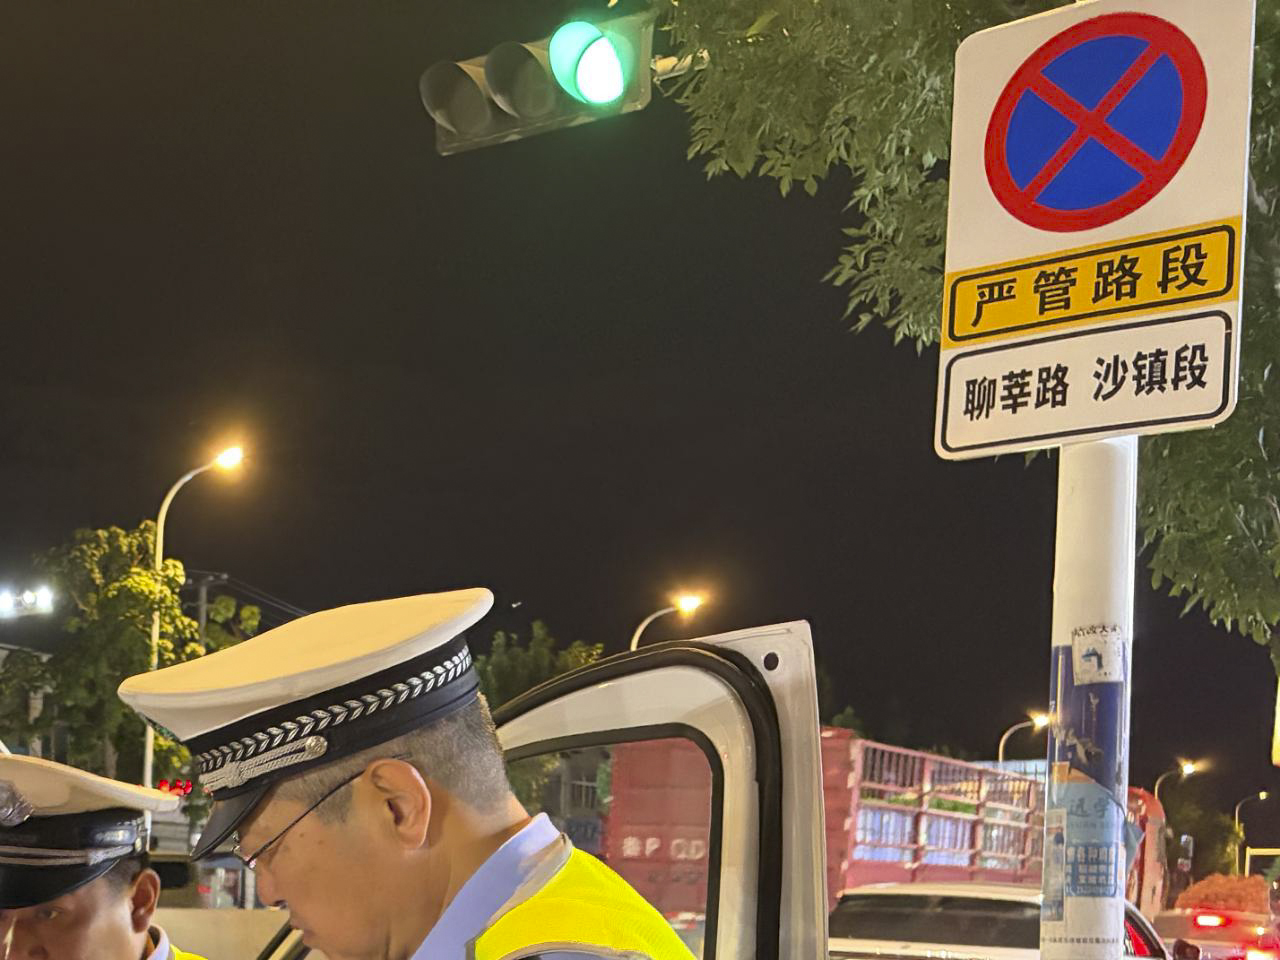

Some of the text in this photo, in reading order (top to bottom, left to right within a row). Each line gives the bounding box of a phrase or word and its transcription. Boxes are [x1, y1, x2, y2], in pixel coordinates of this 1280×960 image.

[971, 243, 1209, 327] 严管路段
[963, 344, 1209, 421] 聊莘路 沙镇段
